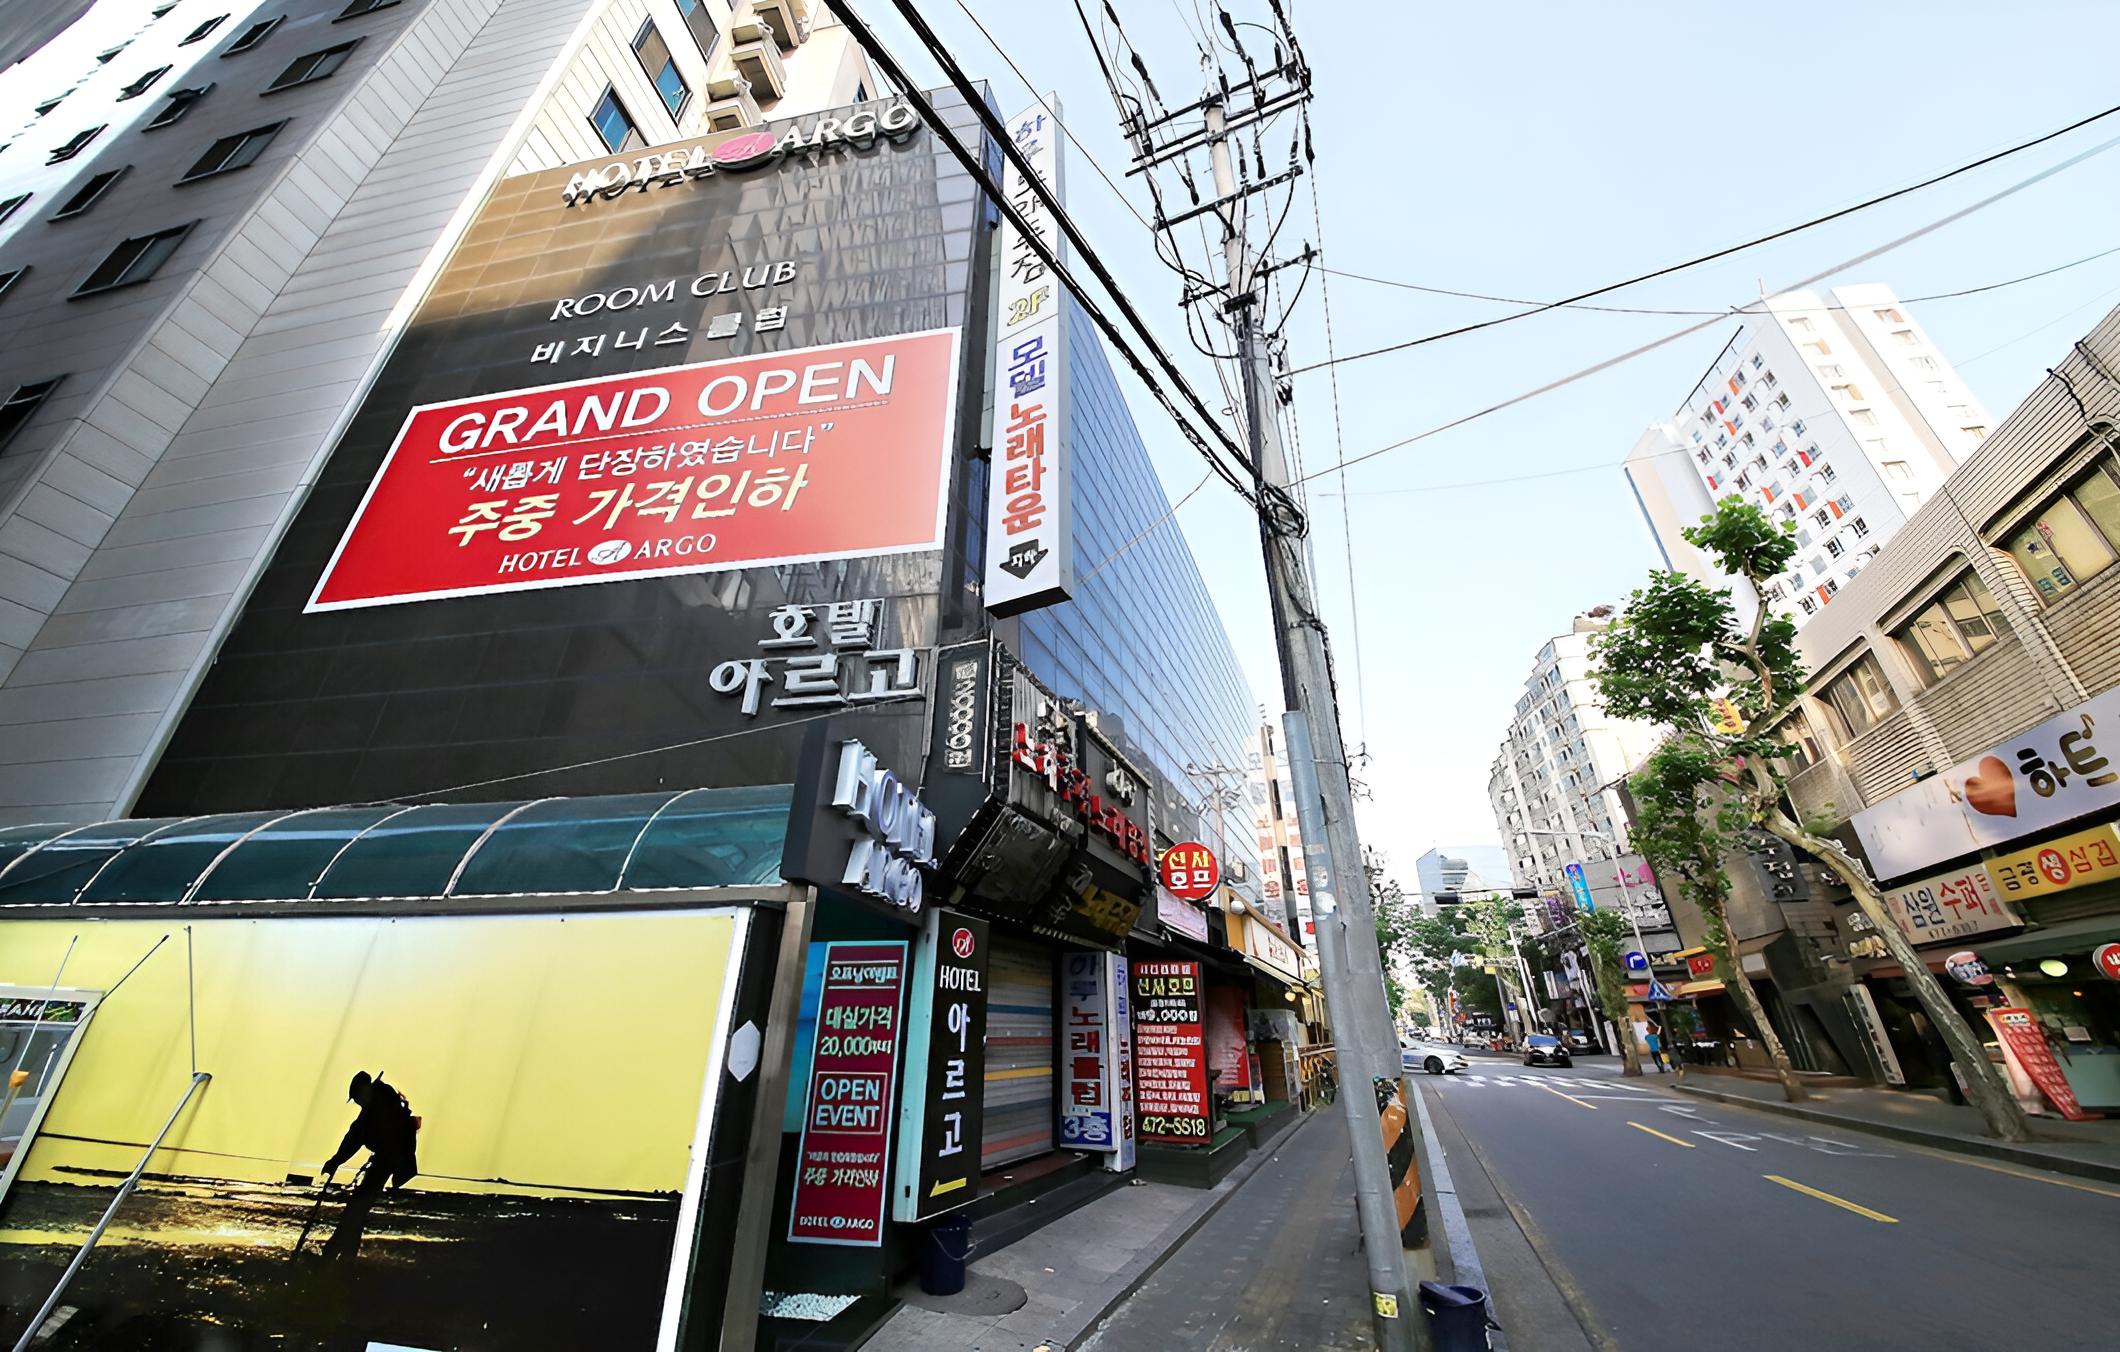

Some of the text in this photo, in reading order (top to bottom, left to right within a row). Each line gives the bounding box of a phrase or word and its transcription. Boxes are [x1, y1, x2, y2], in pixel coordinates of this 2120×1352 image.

[562, 103, 922, 203] HOTEL ARGO
[550, 261, 796, 321] ROOM CLUB
[530, 305, 788, 364] 비지니스 럽
[438, 353, 896, 454] GRAND OPEN
[1001, 403, 1047, 536] 노래타운
[447, 463, 808, 547] 주중 가격인하
[497, 547, 582, 574] HOTEL
[633, 533, 717, 560] ARGO
[758, 601, 884, 649] 호텔
[708, 648, 926, 716] 아르고
[940, 964, 982, 993] HOTEL
[820, 1077, 880, 1101] OPEN
[938, 1002, 971, 1159] 아르고
[815, 1105, 880, 1129] EVENT
